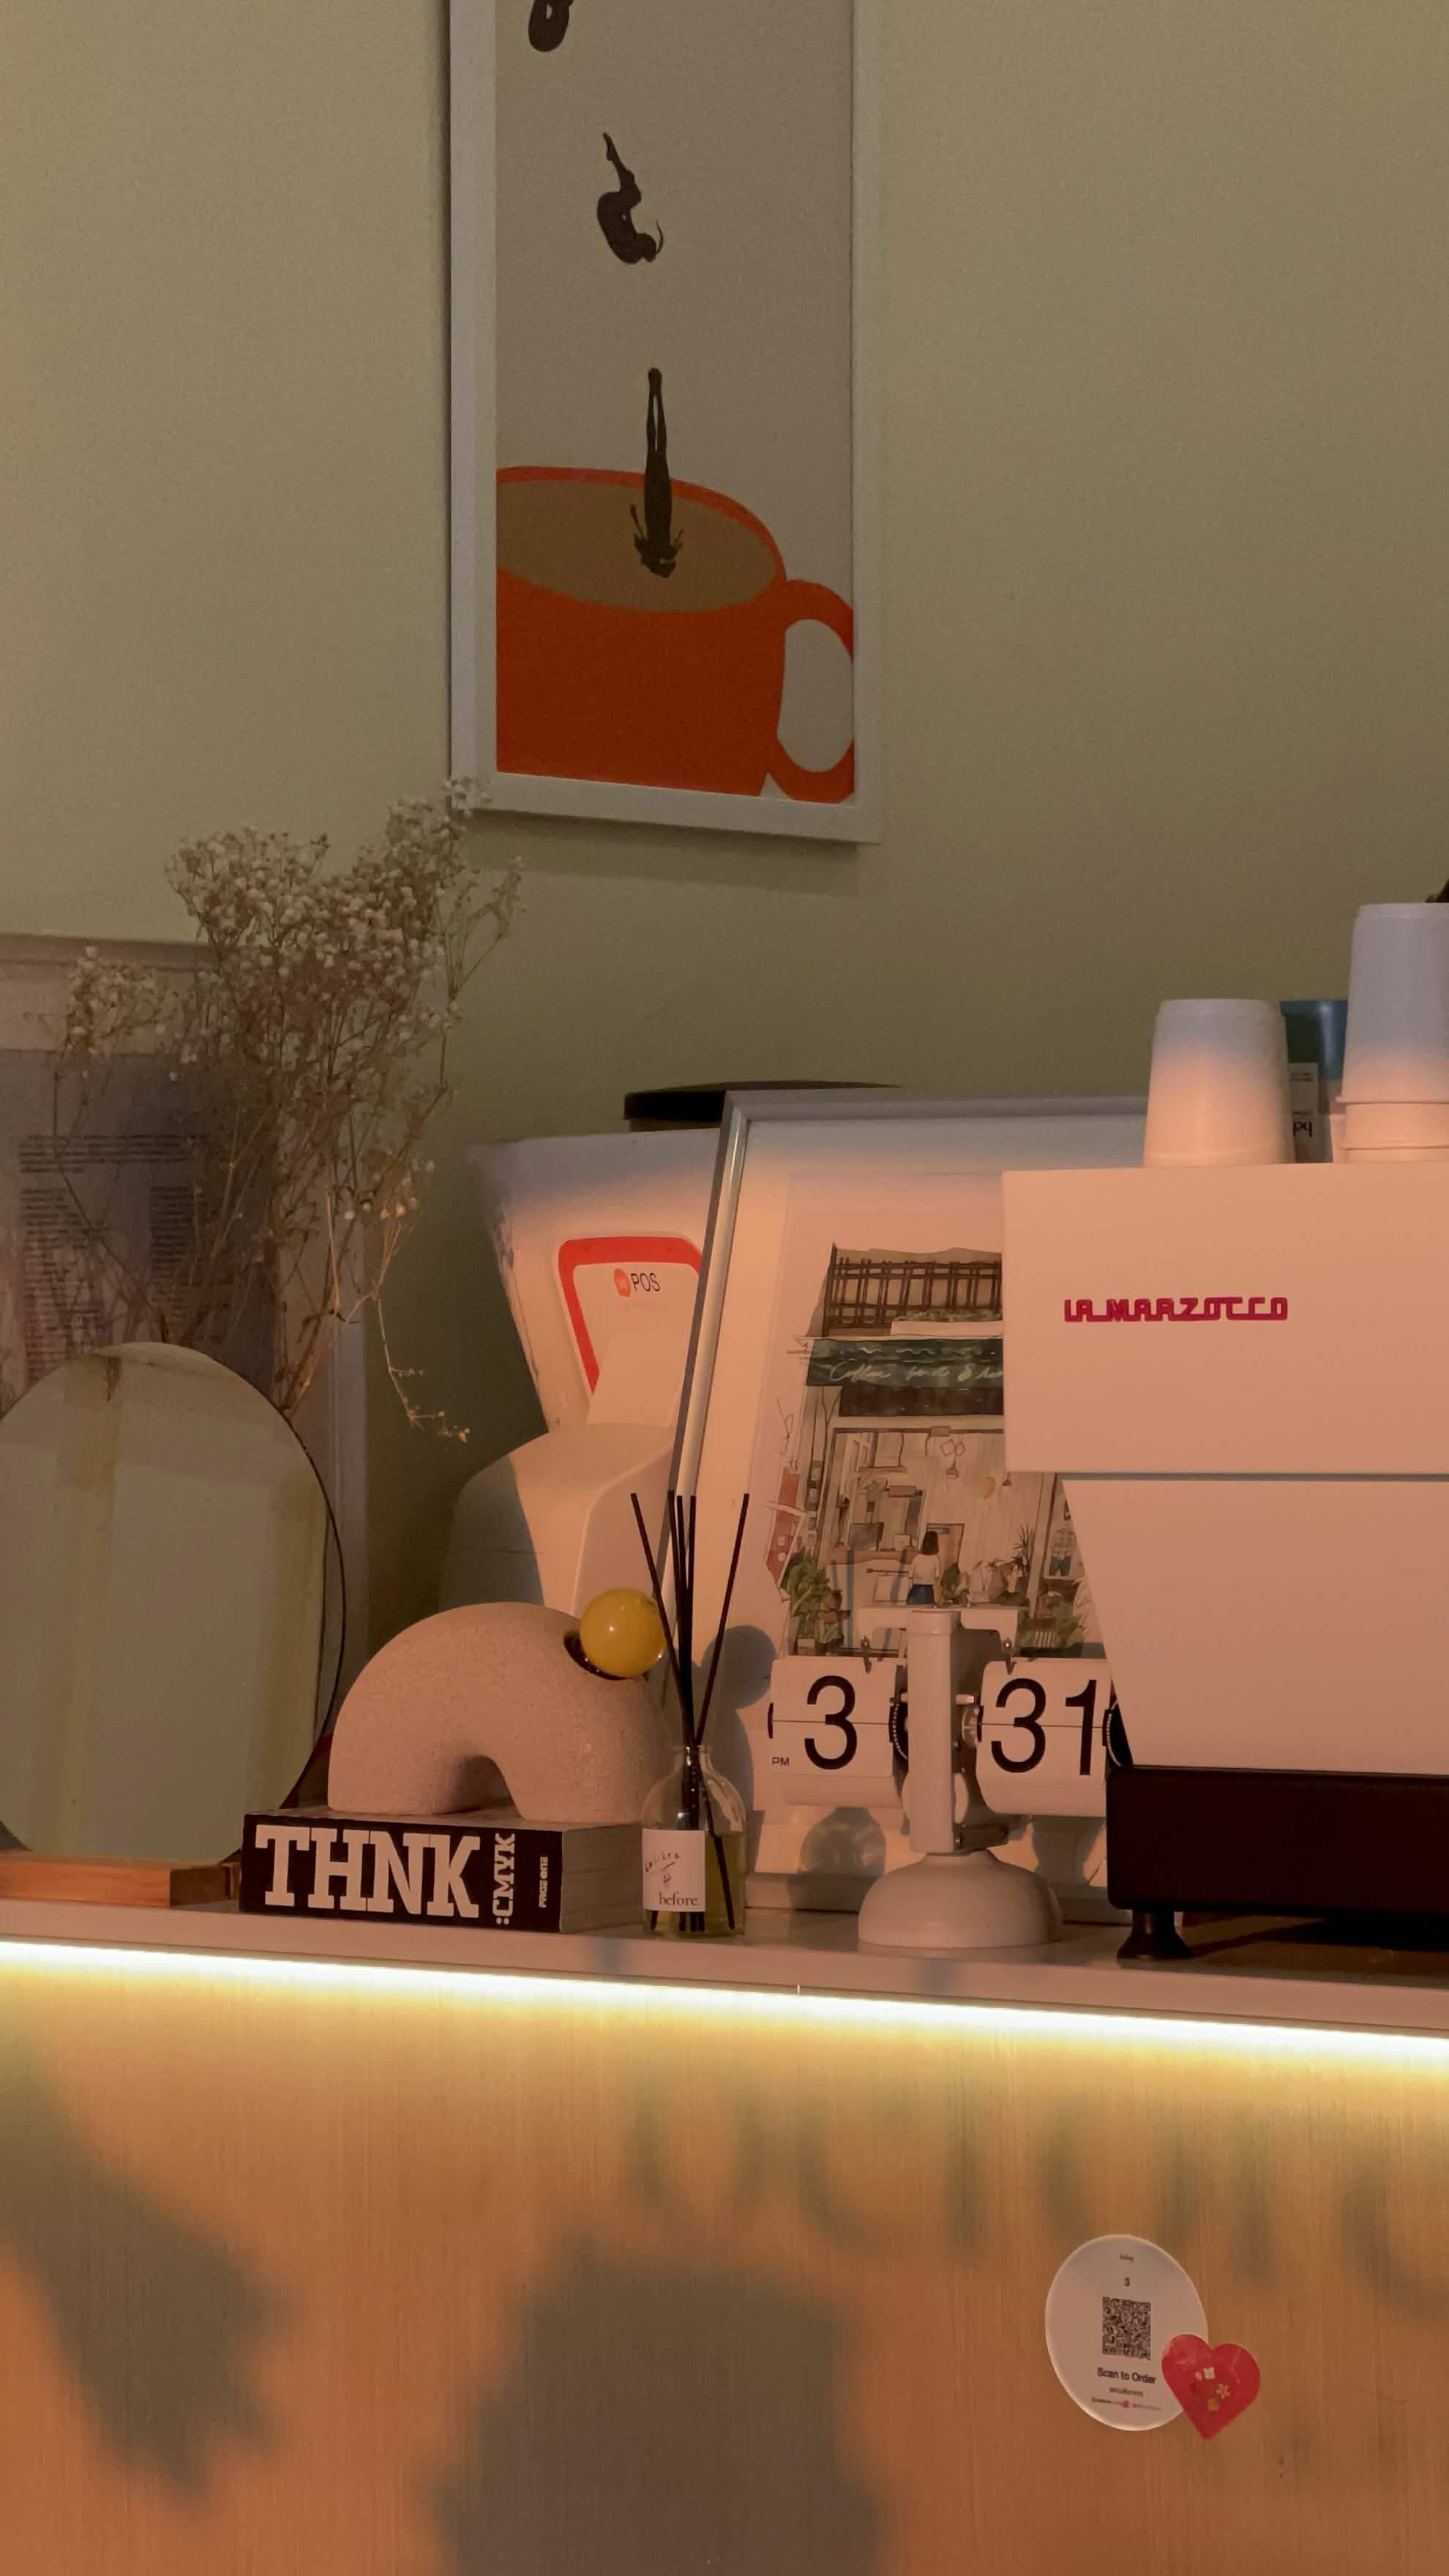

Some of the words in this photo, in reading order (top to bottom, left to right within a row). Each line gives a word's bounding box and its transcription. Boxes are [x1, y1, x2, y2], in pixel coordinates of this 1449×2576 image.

[630, 1273, 661, 1292] POS
[804, 1675, 858, 1770] 3
[990, 1677, 1098, 1776] 31
[771, 1756, 790, 1767] PM
[255, 1824, 481, 1919] THNK
[659, 1890, 698, 1906] before
[1097, 2367, 1119, 2380] Scan
[1120, 2371, 1130, 2381] to
[1131, 2372, 1156, 2384] Order
